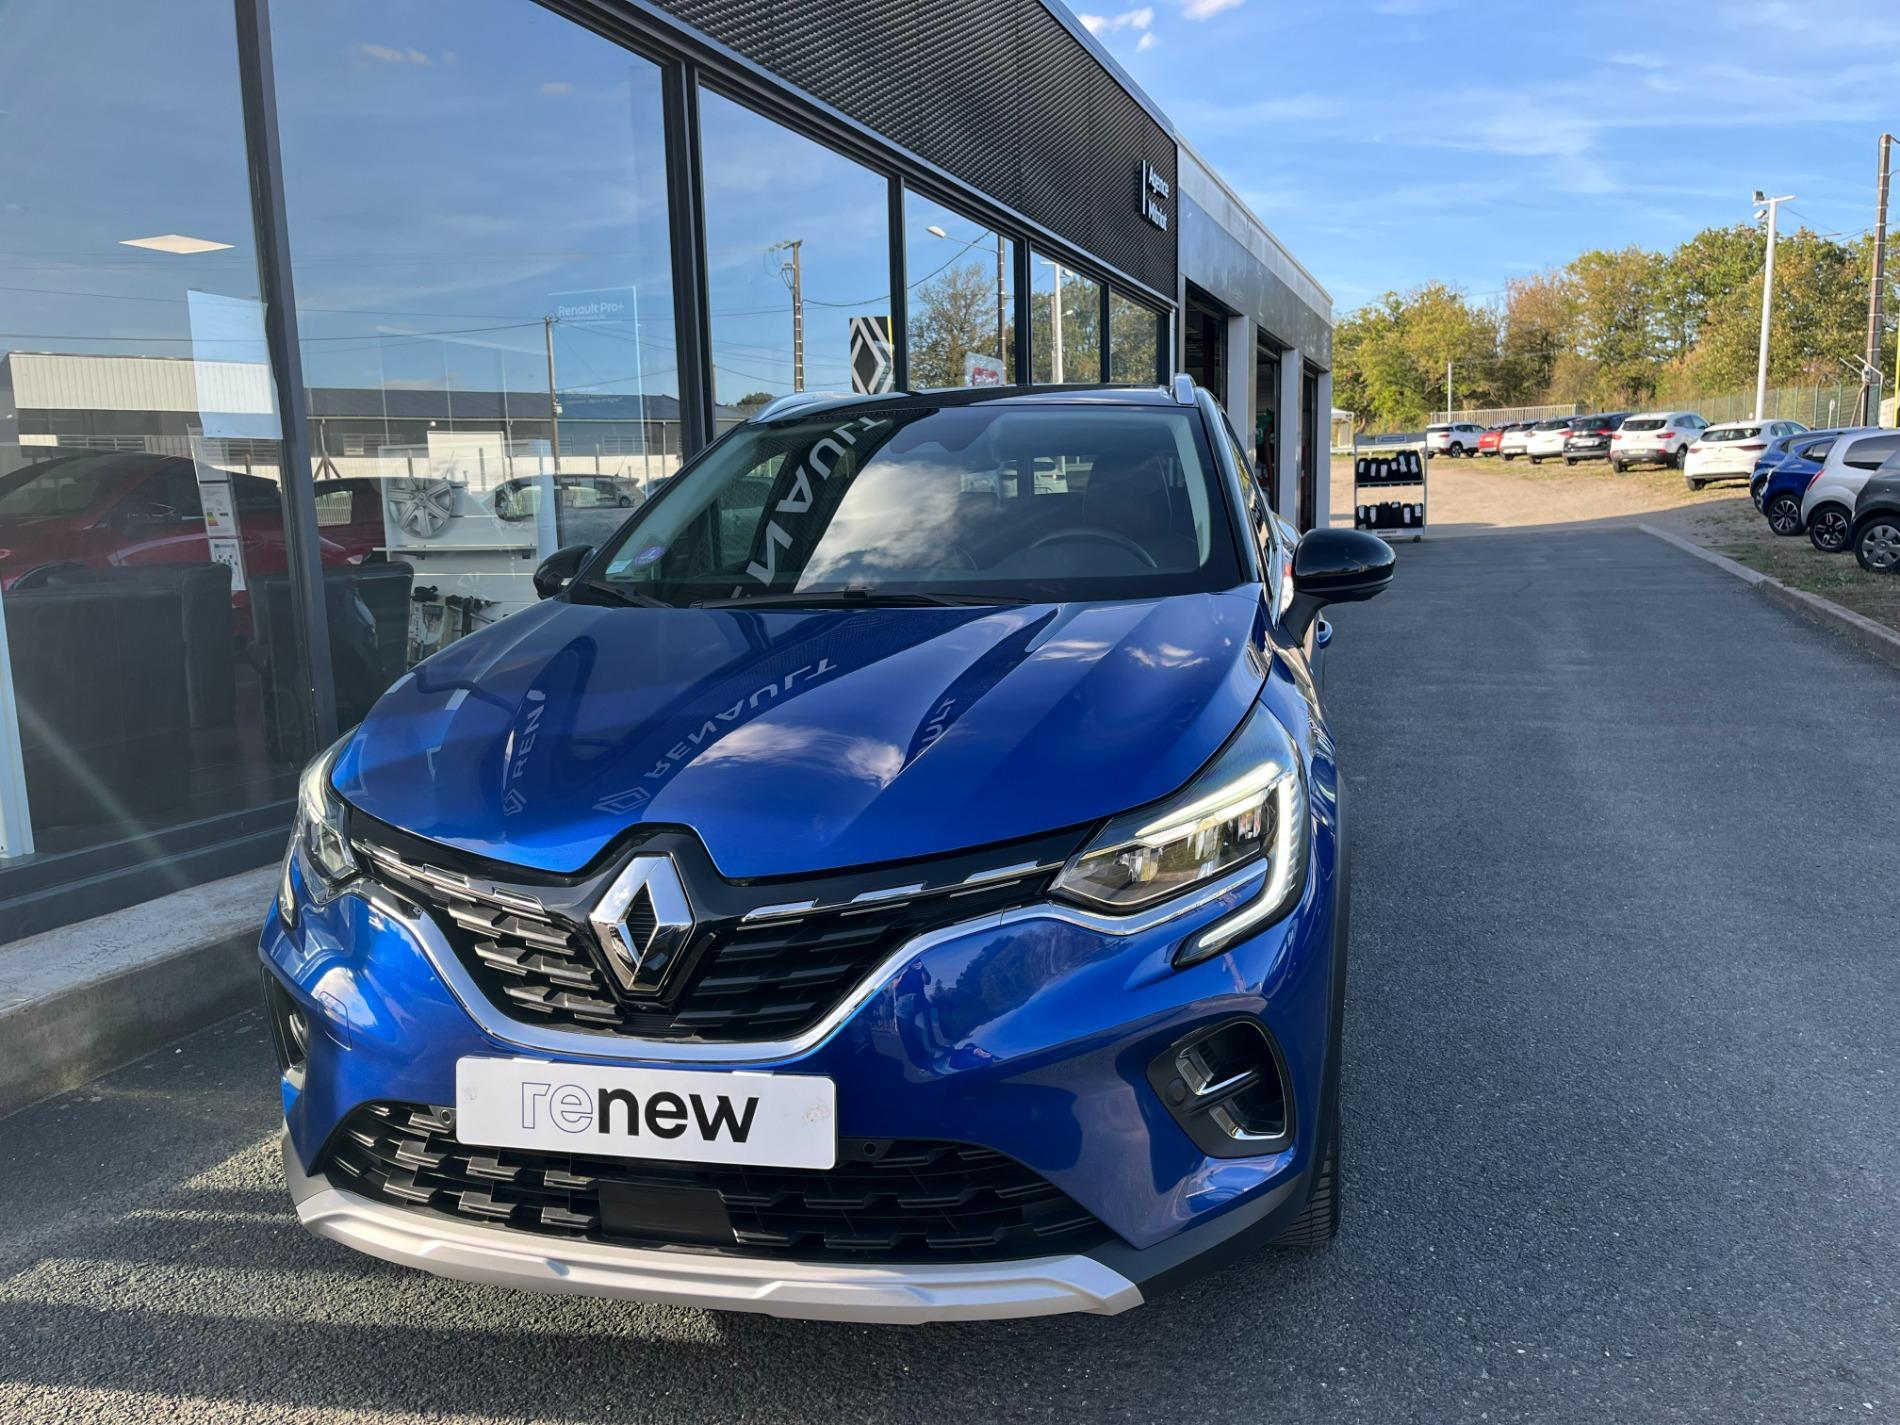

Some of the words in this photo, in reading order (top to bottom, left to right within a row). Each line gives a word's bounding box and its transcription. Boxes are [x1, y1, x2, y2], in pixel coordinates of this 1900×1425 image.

[1148, 165, 1169, 199] Agence
[558, 303, 599, 316] Renault
[600, 301, 625, 314] Pro+
[522, 1081, 760, 1143] renew
